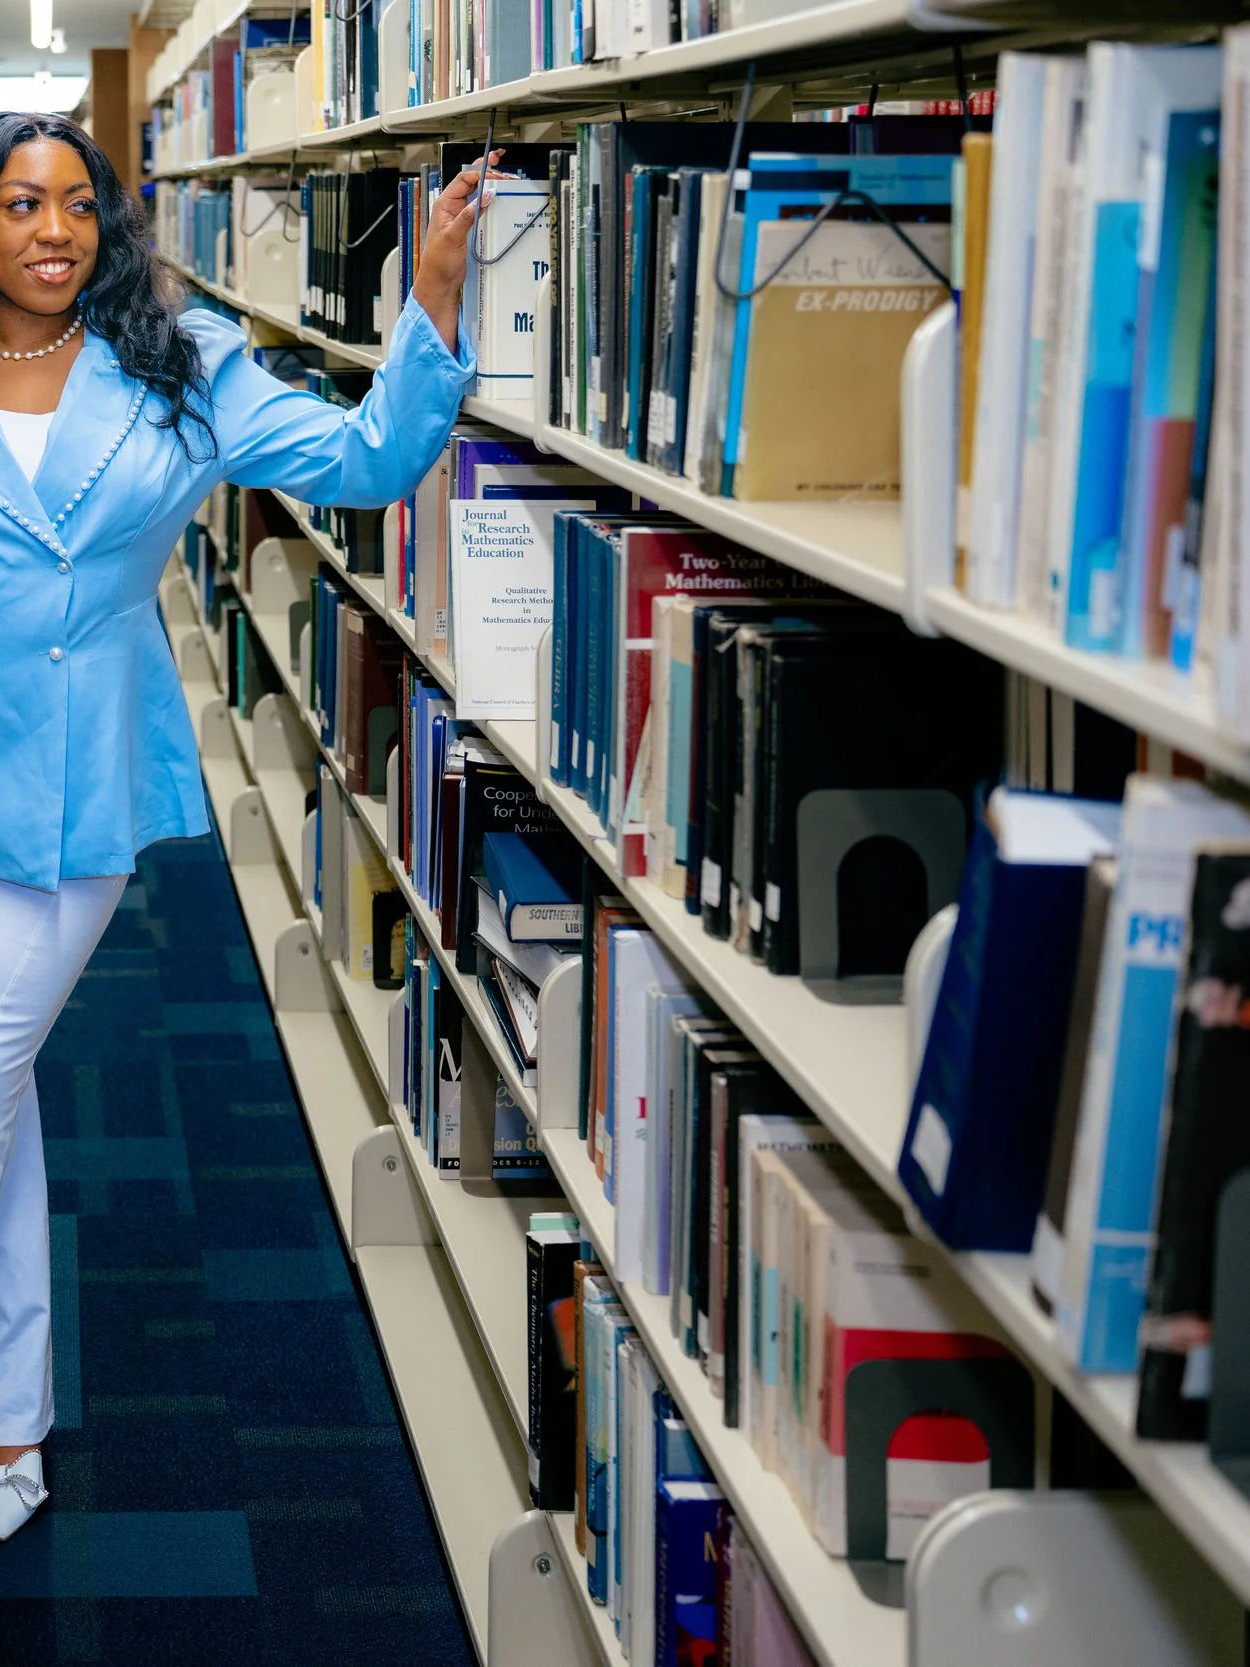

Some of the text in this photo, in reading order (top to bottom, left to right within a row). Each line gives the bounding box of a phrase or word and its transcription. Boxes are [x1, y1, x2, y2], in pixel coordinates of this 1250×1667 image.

[795, 290, 939, 312] EX-PRODIGY
[462, 508, 507, 522] Journal
[478, 522, 530, 534] Research
[462, 534, 534, 546] Mathematics
[467, 546, 524, 558] Education
[678, 553, 767, 570] Two-Year
[664, 573, 784, 590] Mathematics
[506, 587, 548, 596] Qualitative
[493, 804, 558, 819] for Unde
[529, 909, 579, 920] SOUTHERN
